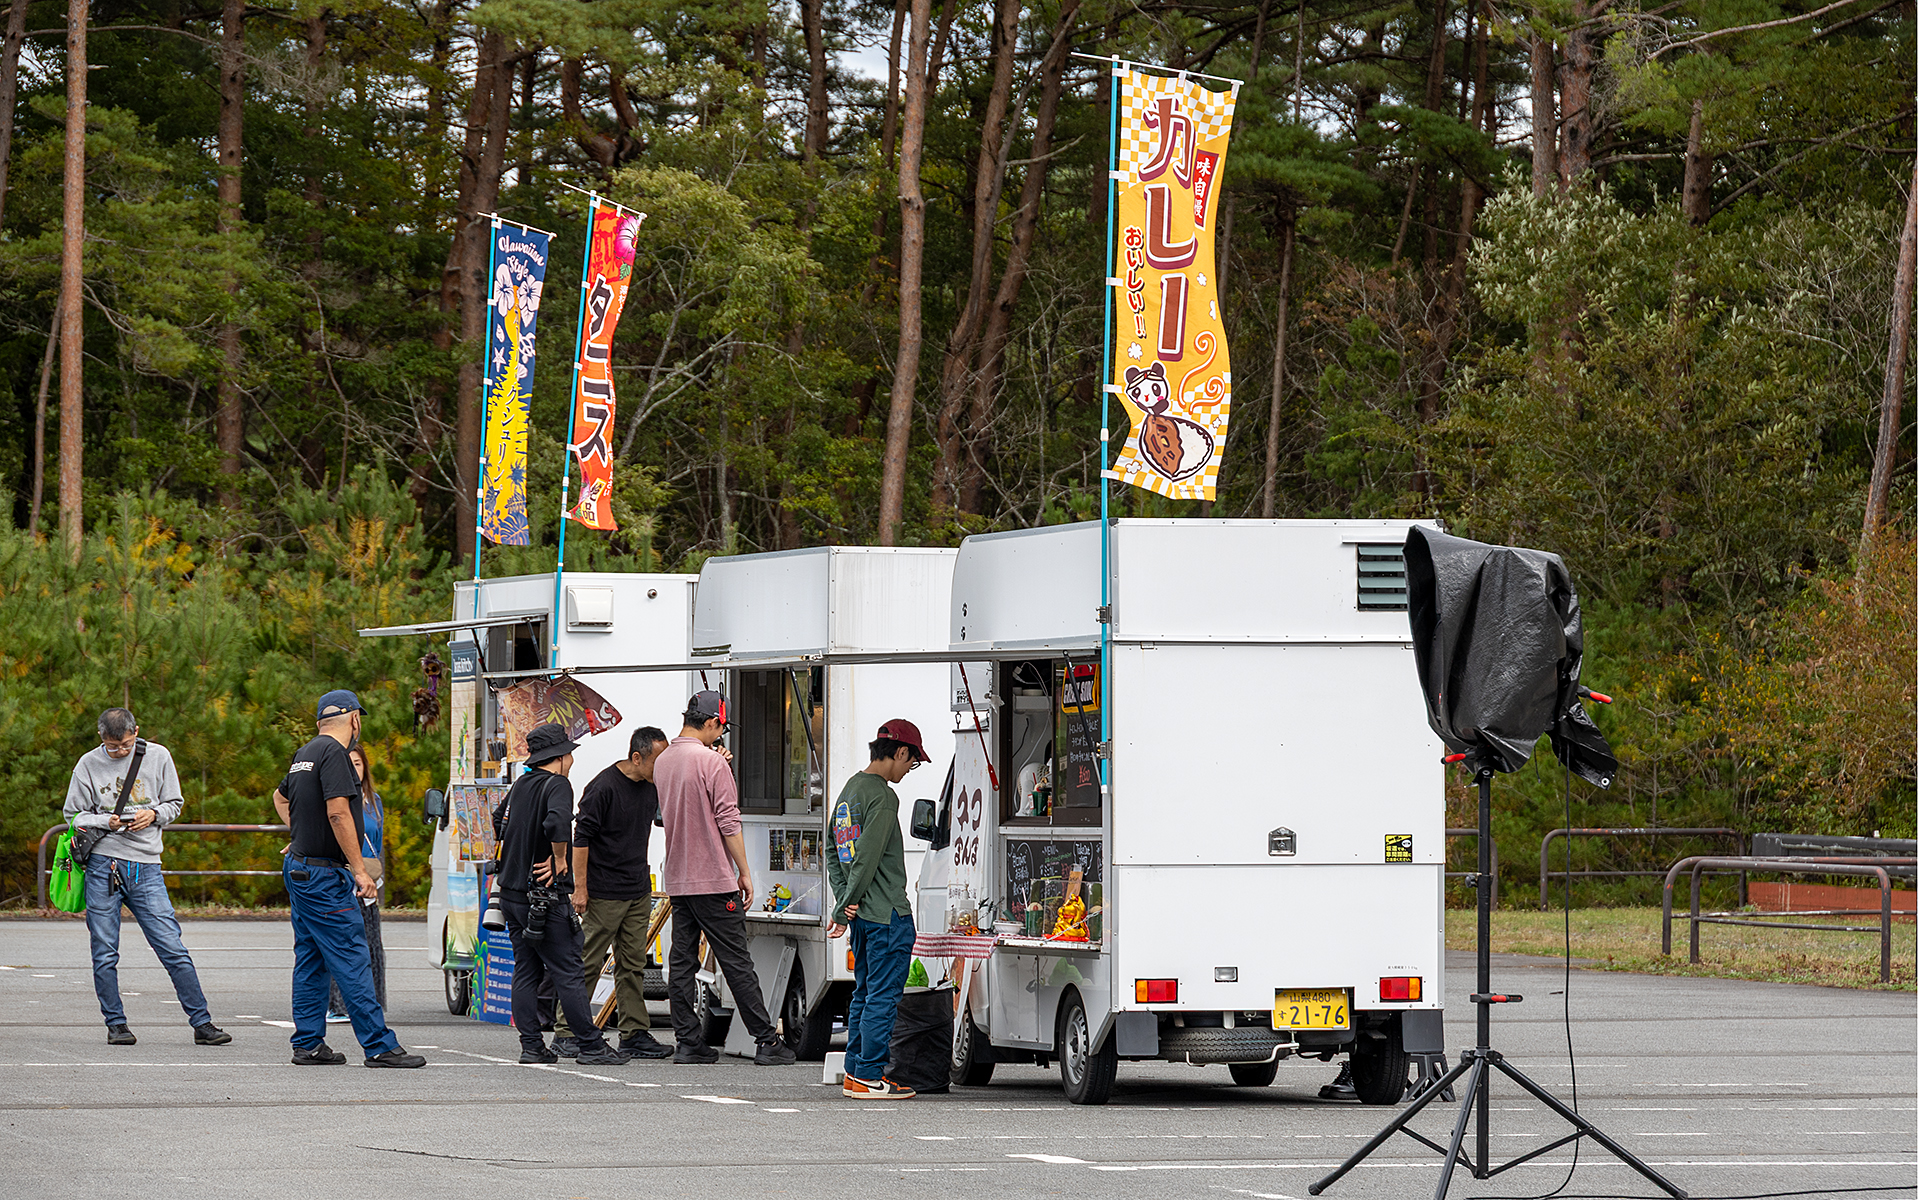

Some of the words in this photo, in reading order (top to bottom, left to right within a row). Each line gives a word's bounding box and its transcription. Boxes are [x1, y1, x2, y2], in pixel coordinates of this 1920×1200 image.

[1194, 157, 1211, 219] 味自慢
[1139, 97, 1198, 362] カレー
[498, 235, 545, 266] Hawaiian
[506, 255, 529, 281] Style
[954, 835, 980, 867] まんま
[1279, 1010, 1287, 1021] す
[1290, 1005, 1344, 1025] 21-76
